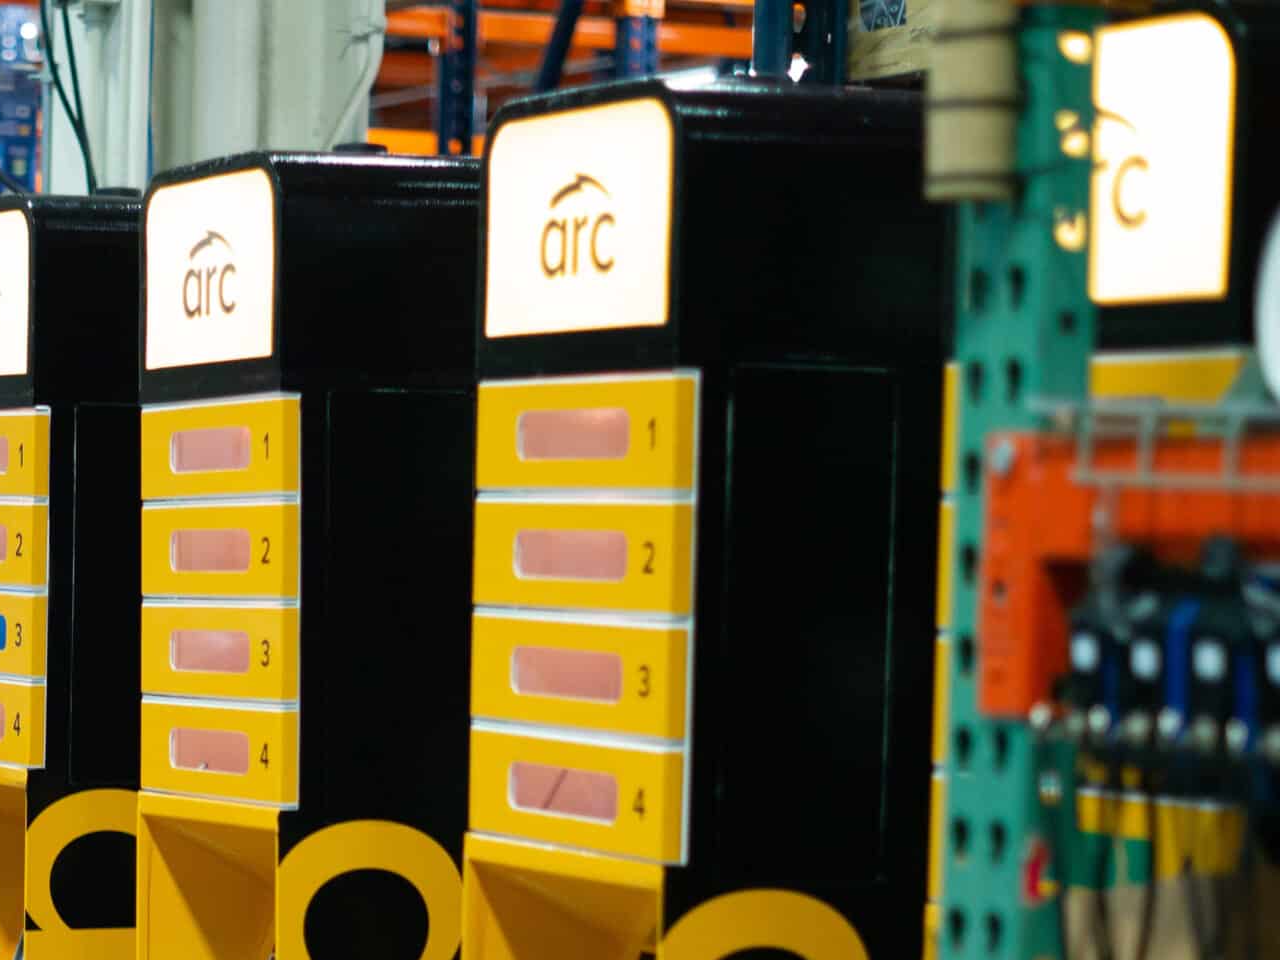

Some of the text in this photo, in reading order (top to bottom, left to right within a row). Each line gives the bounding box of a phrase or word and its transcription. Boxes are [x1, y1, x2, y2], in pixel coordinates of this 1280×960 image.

[540, 212, 616, 278] arc
[183, 263, 237, 319] arc
[263, 432, 269, 457] 1
[647, 418, 657, 448] 1
[18, 443, 24, 467] 1
[15, 532, 23, 558] 2
[260, 536, 270, 565] 2
[642, 541, 655, 575] 2
[14, 622, 22, 648] 3
[260, 639, 270, 668] 3
[638, 664, 651, 699] 3
[13, 712, 21, 737] 4
[259, 743, 269, 769] 4
[632, 789, 646, 817] 4
